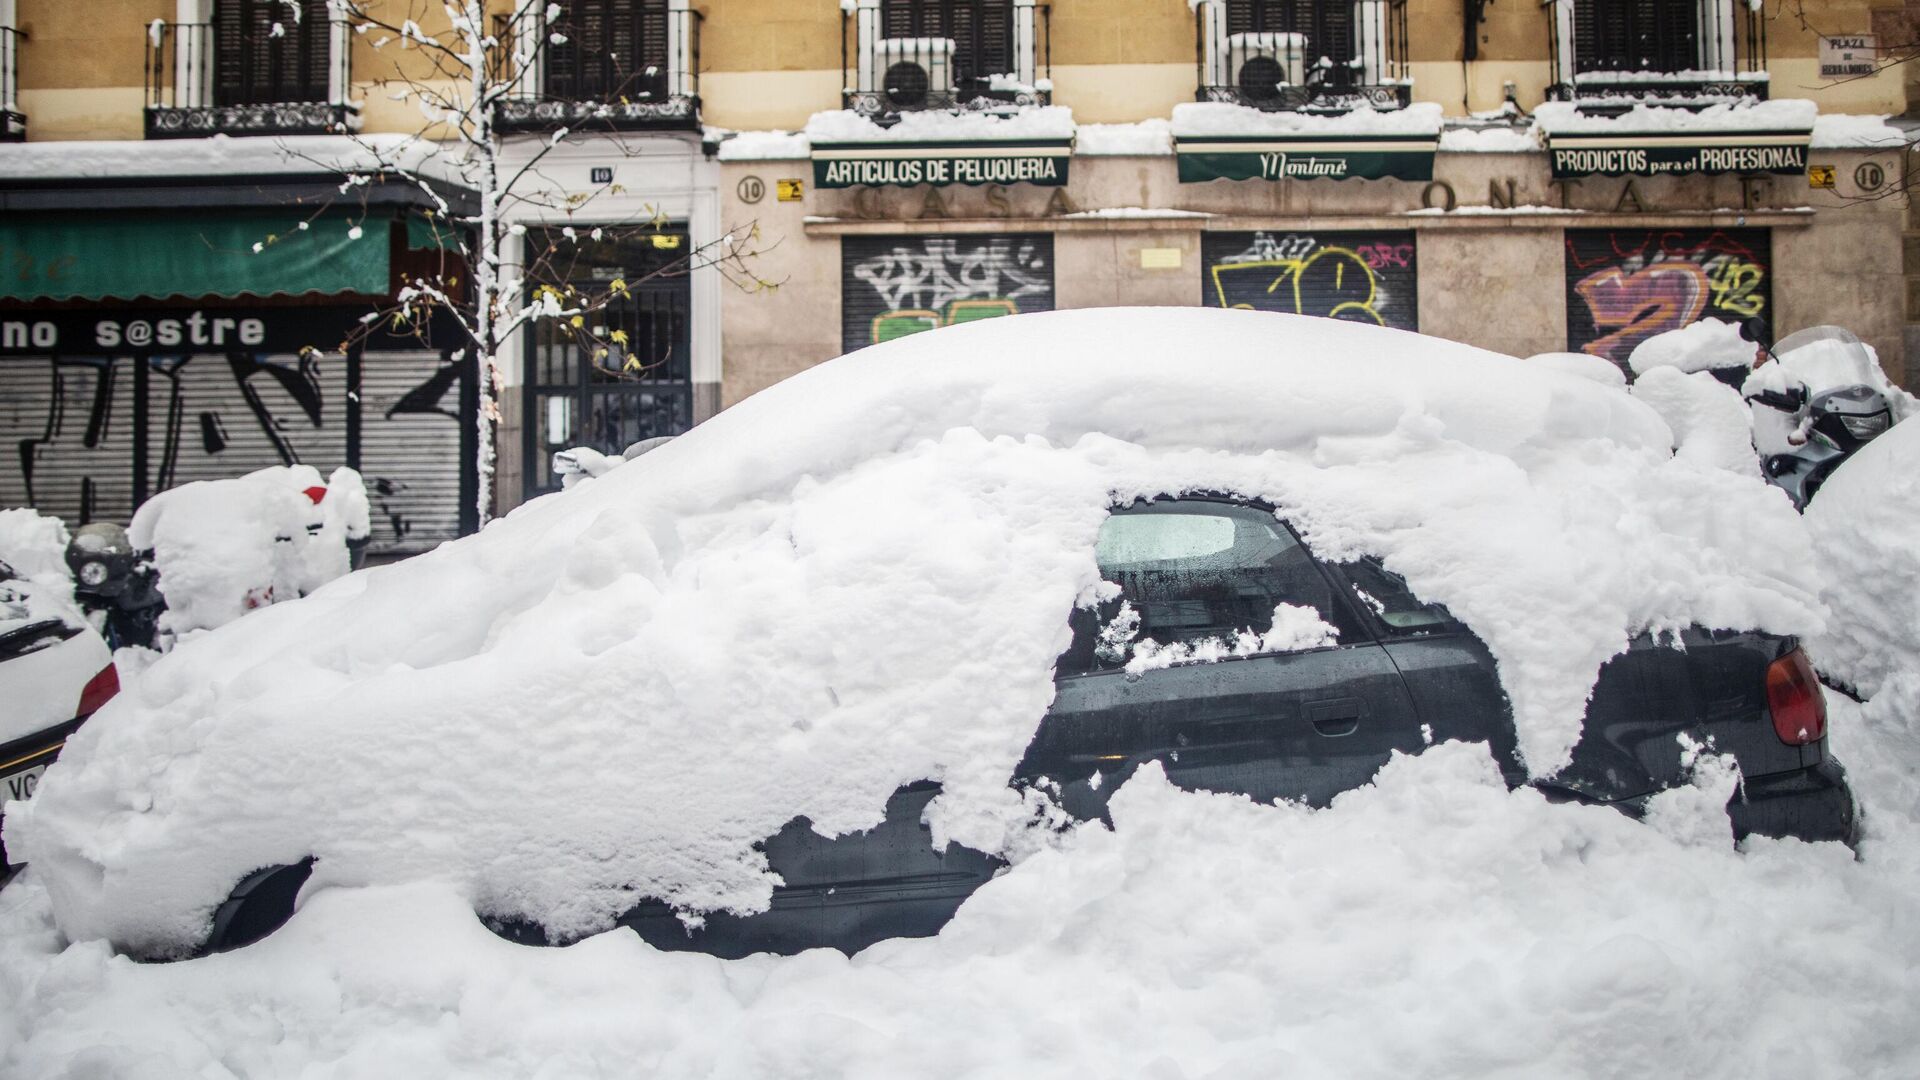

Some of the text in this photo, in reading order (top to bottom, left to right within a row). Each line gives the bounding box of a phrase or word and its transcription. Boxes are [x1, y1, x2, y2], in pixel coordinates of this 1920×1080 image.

[1830, 39, 1865, 49] PLAZA
[1556, 147, 1805, 174] PRODUCTOS para el PROFESIONAL
[594, 169, 611, 181] 10
[826, 158, 1057, 183] ARTICULOS DE PELUQUERIA
[1861, 168, 1879, 186] 10
[744, 182, 760, 199] 10
[3, 311, 265, 348] no s@stre
